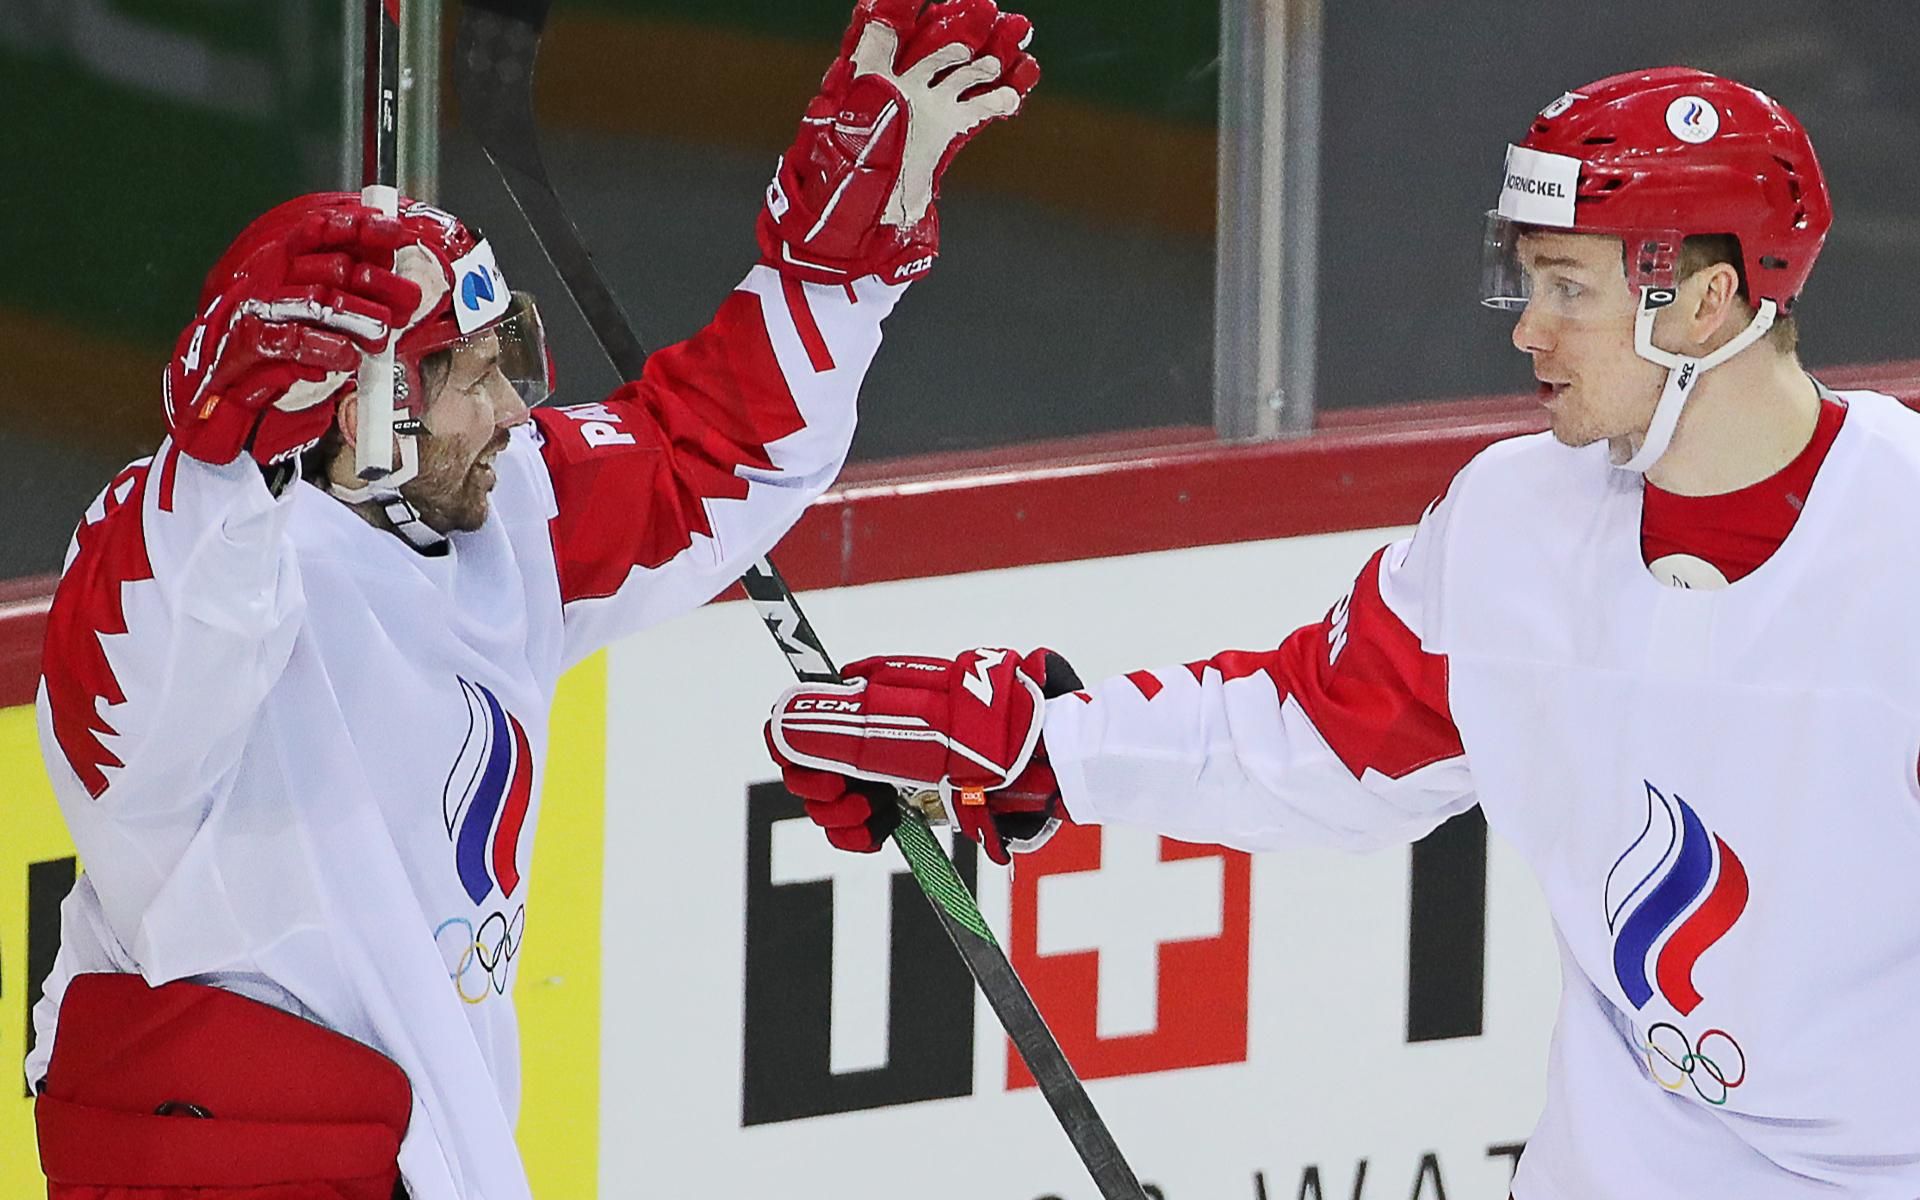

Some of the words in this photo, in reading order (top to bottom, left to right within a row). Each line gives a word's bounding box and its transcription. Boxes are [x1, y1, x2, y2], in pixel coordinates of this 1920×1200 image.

[893, 255, 933, 279] CCM
[393, 421, 421, 429] CCM
[553, 402, 637, 449] PA
[794, 699, 862, 713] CCM
